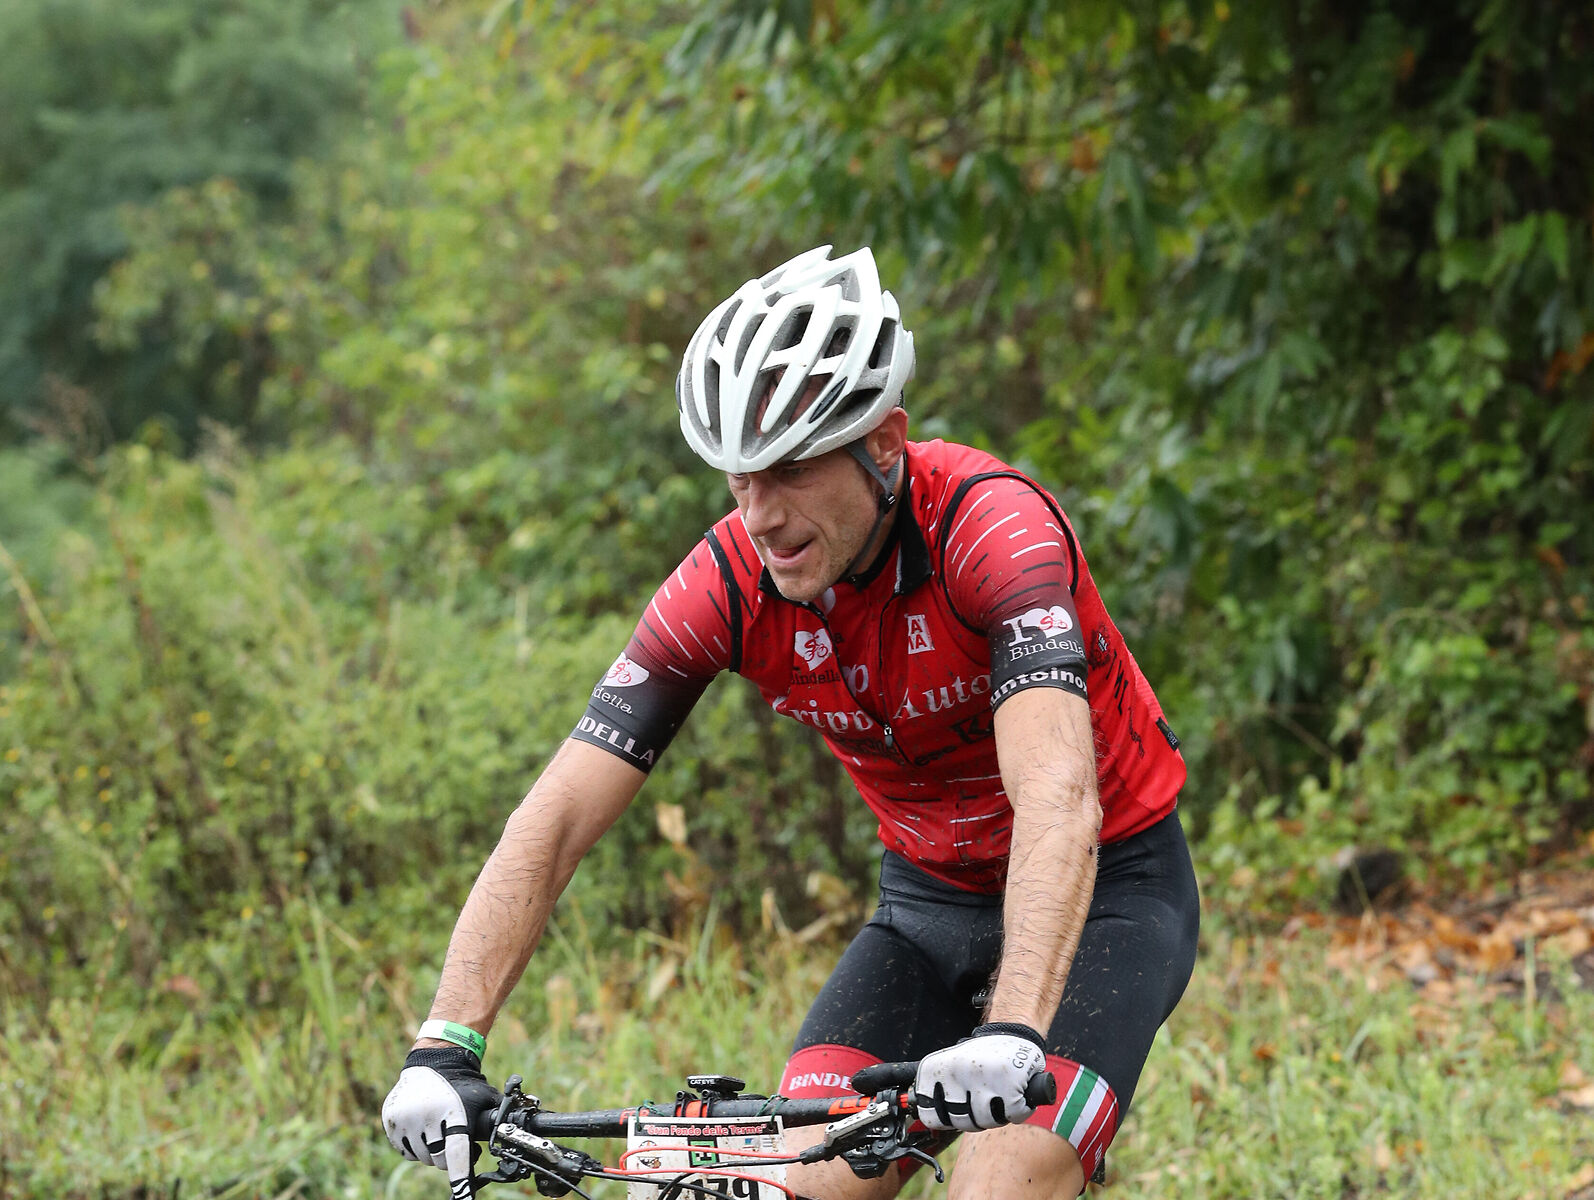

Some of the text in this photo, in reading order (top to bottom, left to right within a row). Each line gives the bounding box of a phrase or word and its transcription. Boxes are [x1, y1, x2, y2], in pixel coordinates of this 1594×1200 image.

[1009, 639, 1086, 662] Bindella
[592, 687, 633, 715] della
[670, 1125, 701, 1136] Fondo
[702, 1125, 729, 1136] delle
